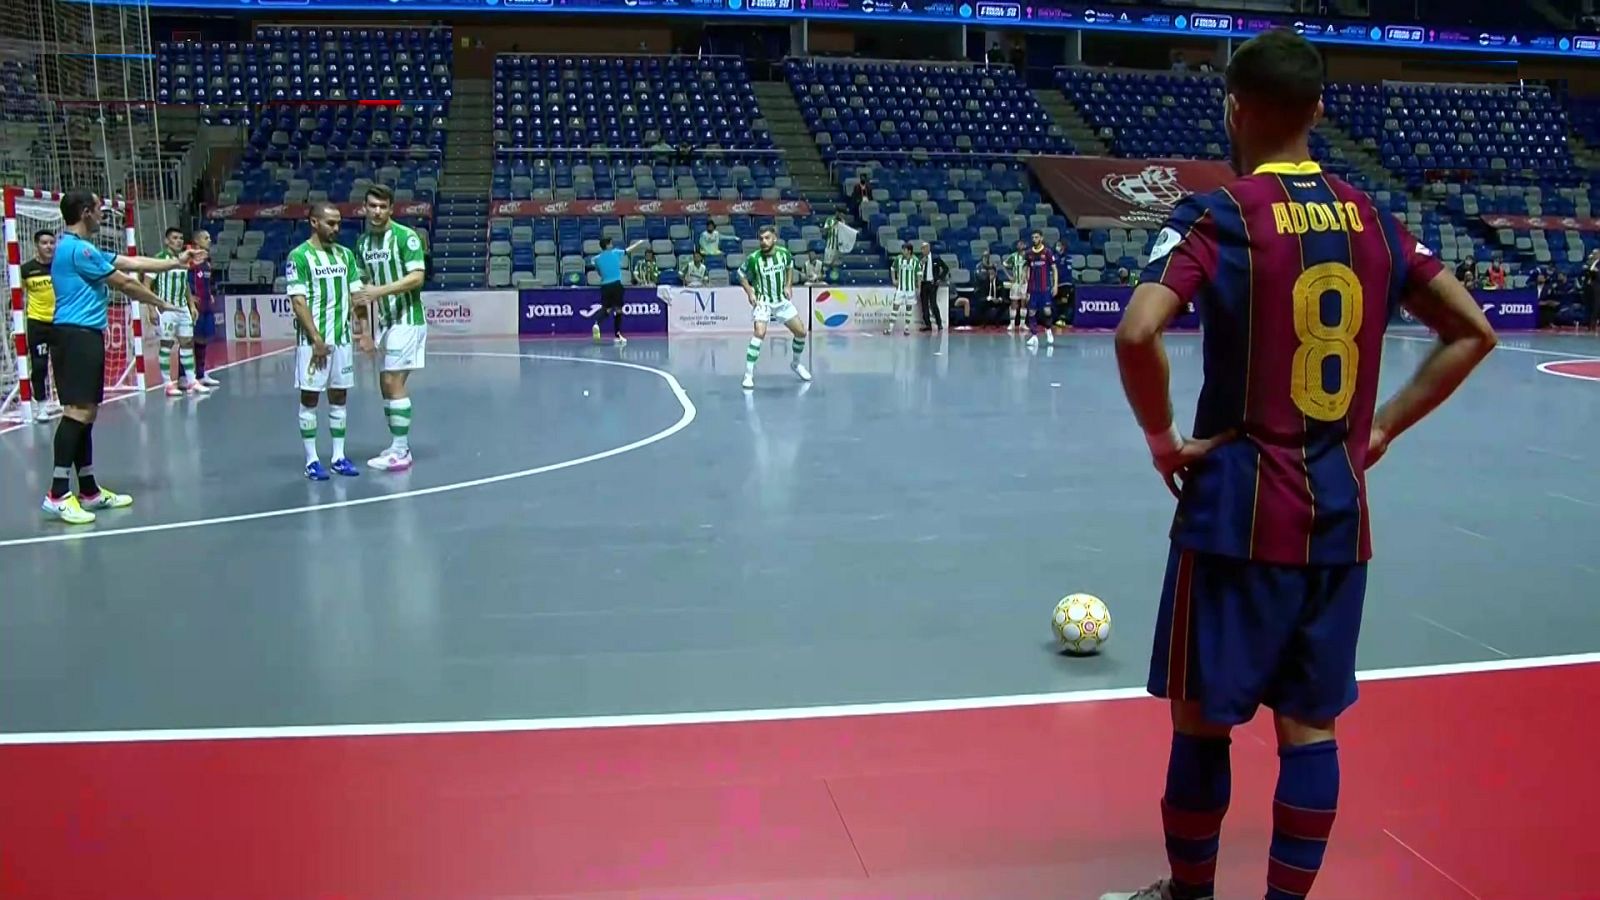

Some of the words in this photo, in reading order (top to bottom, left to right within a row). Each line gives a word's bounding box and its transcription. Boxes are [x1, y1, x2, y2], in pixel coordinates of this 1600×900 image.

[1271, 201, 1364, 235] ADOLFO
[365, 250, 390, 261] betway
[315, 265, 348, 277] betway
[426, 304, 471, 319] azorla
[36, 342, 49, 356] 12
[1290, 262, 1363, 422] 8
